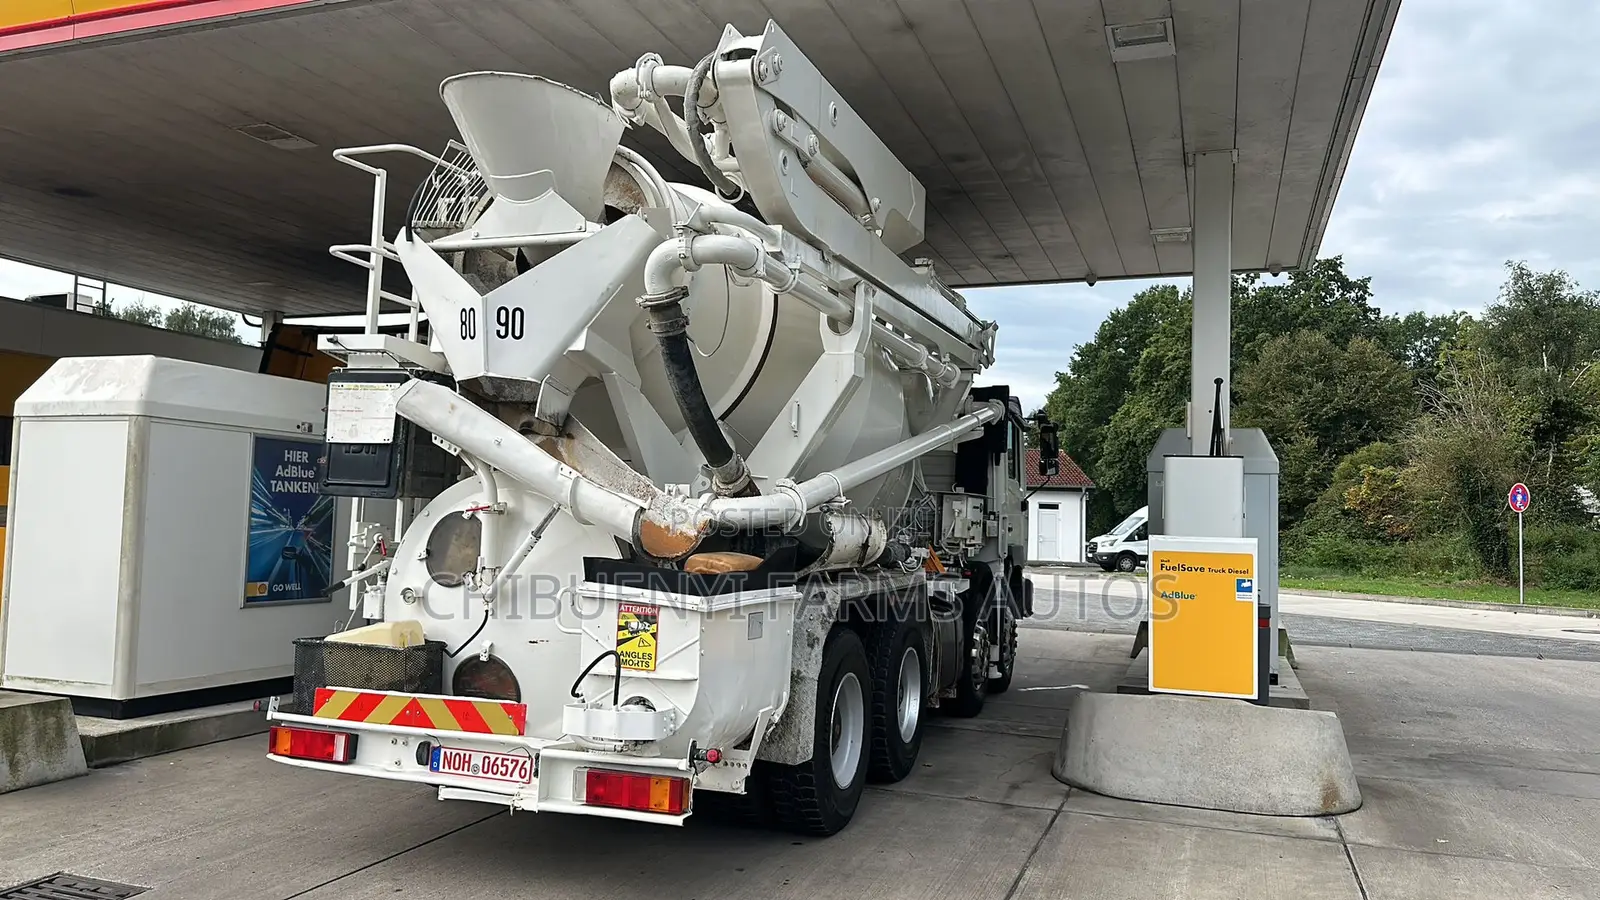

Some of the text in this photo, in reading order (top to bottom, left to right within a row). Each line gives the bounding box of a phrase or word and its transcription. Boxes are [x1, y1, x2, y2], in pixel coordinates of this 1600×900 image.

[460, 307, 476, 340] 80
[496, 305, 524, 340] 90
[284, 450, 309, 463] HIER
[270, 480, 319, 493] TANKEN!
[1160, 563, 1206, 573] FuelSave
[272, 583, 301, 592] GO WELL
[620, 604, 657, 614] ATTENTION
[620, 650, 652, 660] ANGLES
[621, 658, 650, 668] MORTS
[443, 751, 472, 772] NOH
[482, 756, 527, 779] 06576
